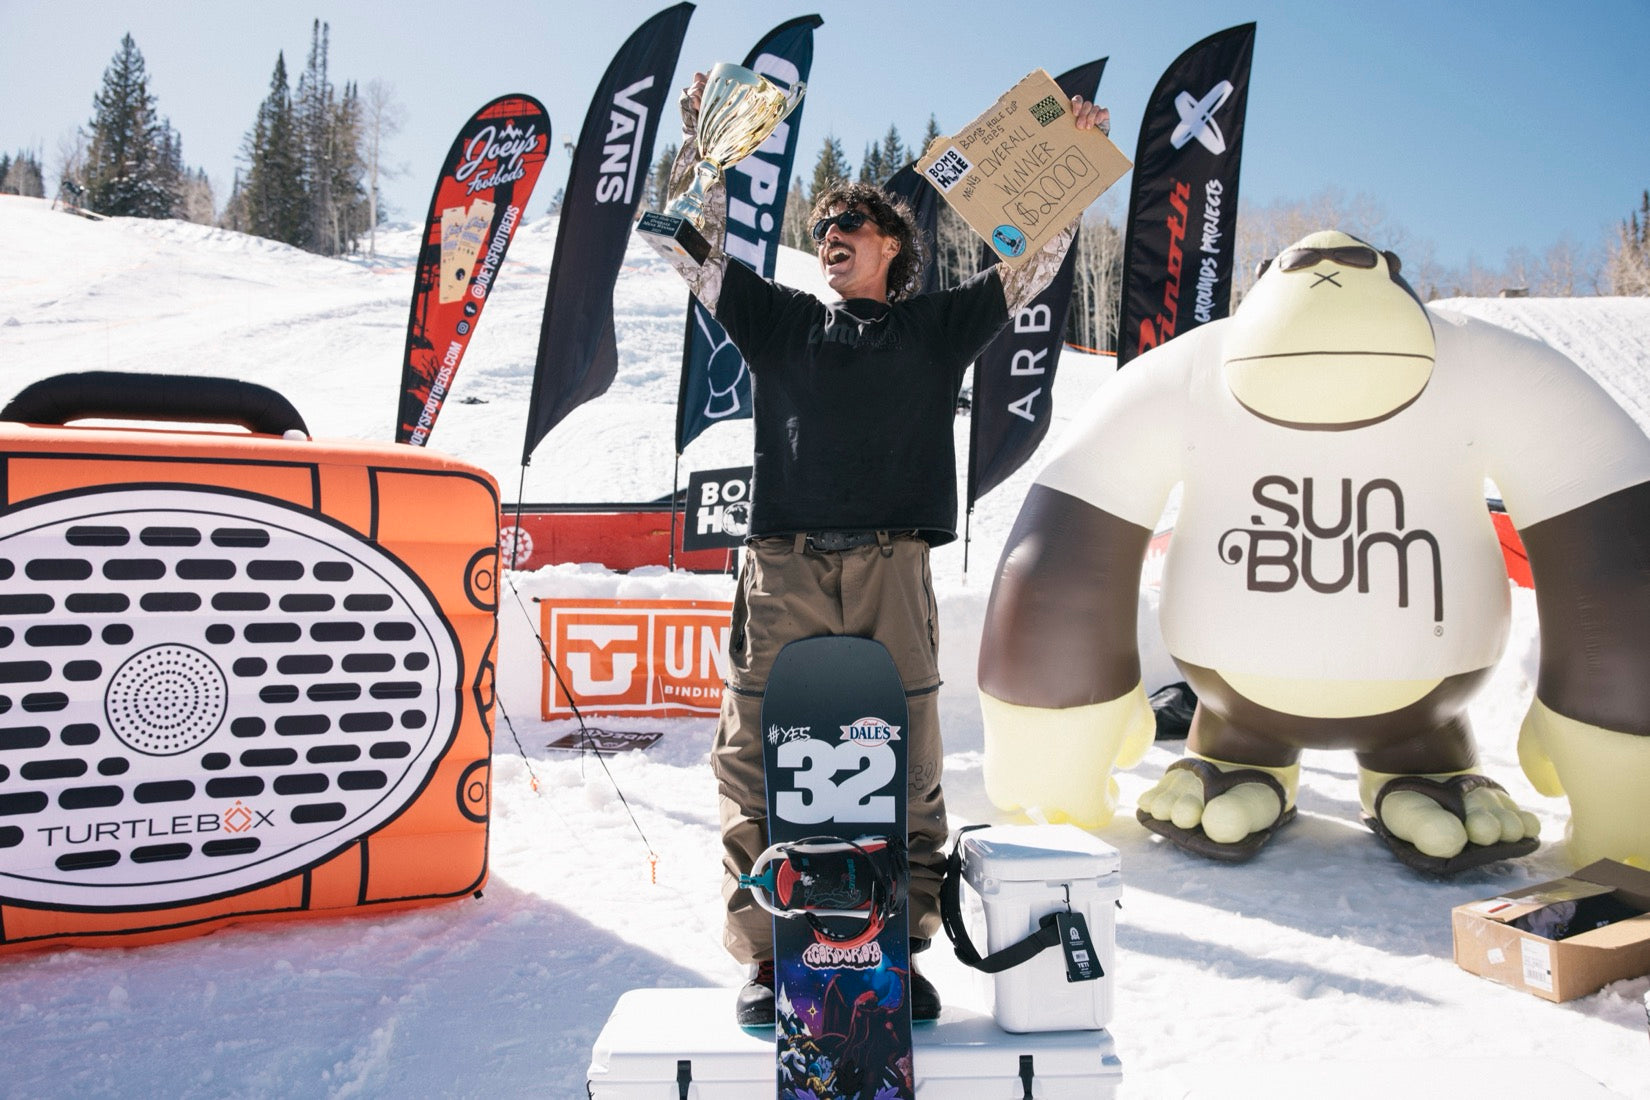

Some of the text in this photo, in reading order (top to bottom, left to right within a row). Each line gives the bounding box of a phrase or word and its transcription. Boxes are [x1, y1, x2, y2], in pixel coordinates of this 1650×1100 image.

[595, 75, 655, 205] VANS
[959, 127, 986, 150] BOMB
[986, 112, 1005, 129] HOLE
[1005, 100, 1018, 116] CUP
[981, 125, 1005, 145] 2025
[456, 124, 538, 181] Joey's
[928, 149, 958, 178] BOMB
[937, 158, 969, 188] HOLE
[978, 125, 1035, 178] OVERALL
[466, 158, 525, 196] Footbeds
[1016, 154, 1089, 226] $2000
[471, 205, 520, 299] @JOEYSFOOTBEDS
[1194, 178, 1223, 323] GROUNDS PROJECTS
[700, 479, 752, 506] BO
[664, 685, 727, 699] BINDIN
[767, 723, 811, 745] #YES
[850, 725, 891, 740] DALE'S
[776, 738, 897, 825] 32
